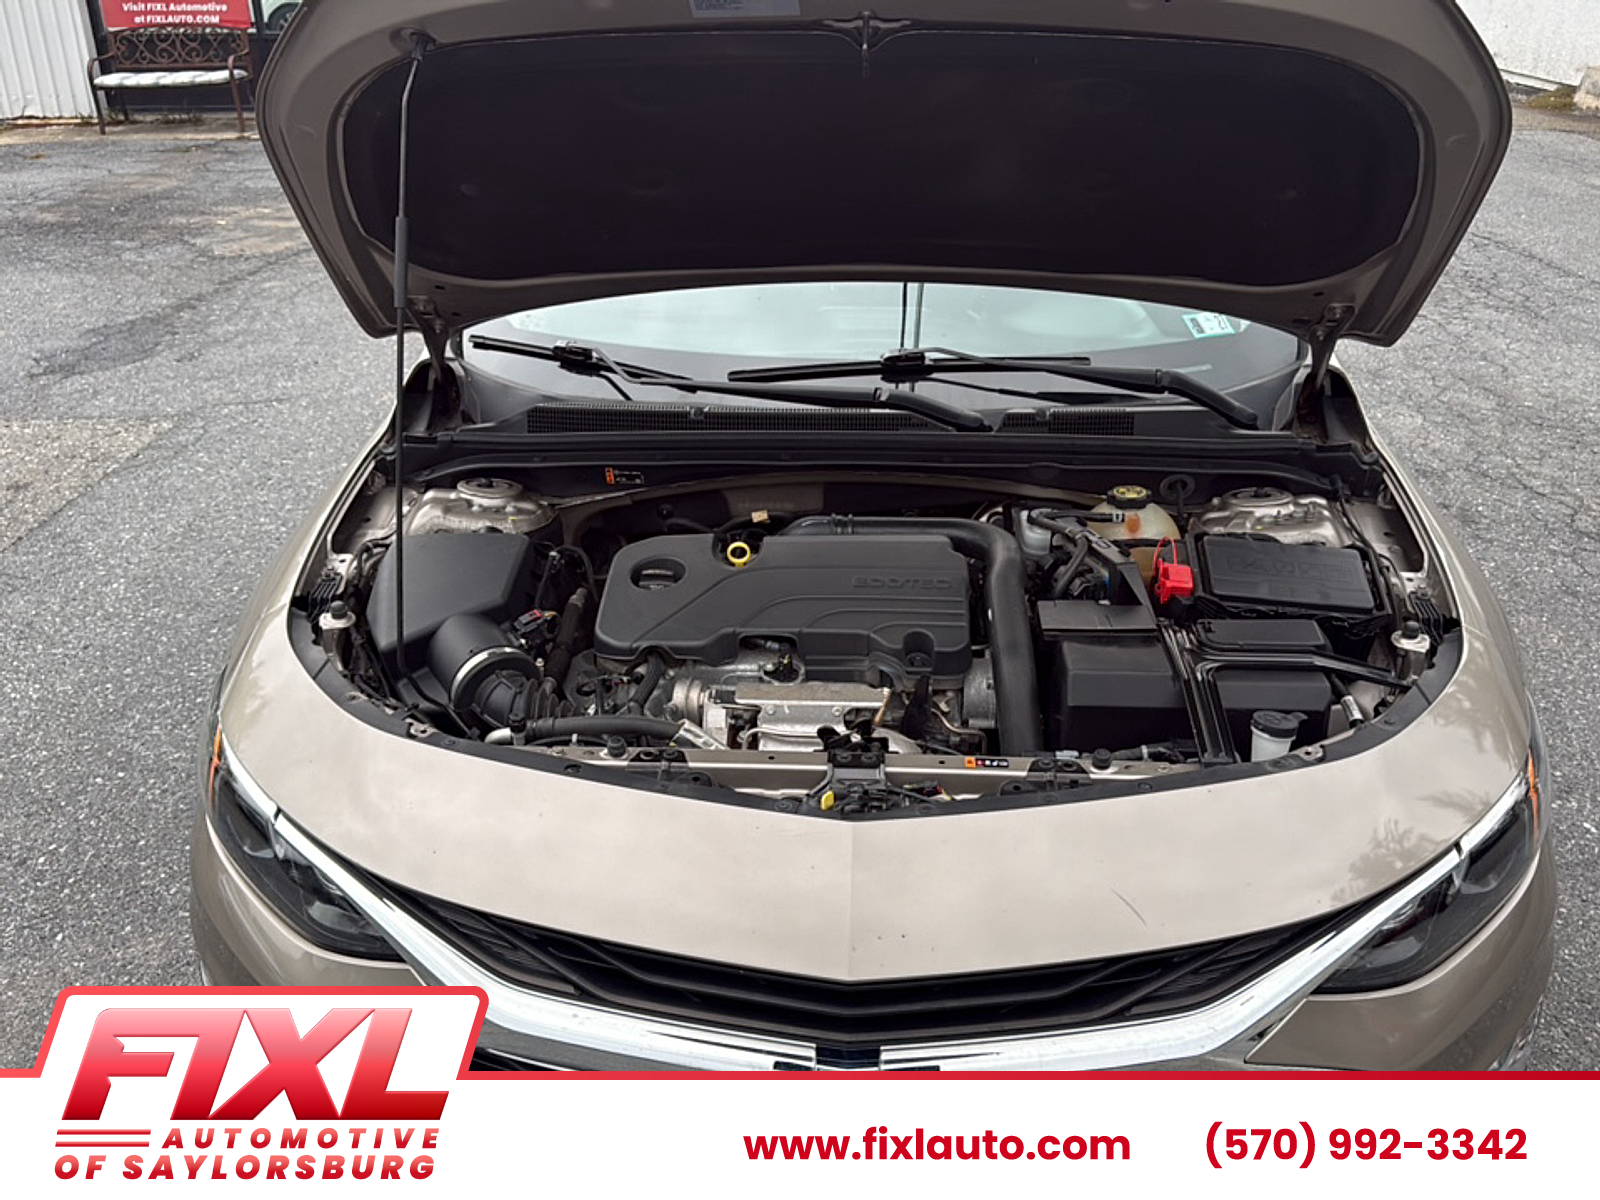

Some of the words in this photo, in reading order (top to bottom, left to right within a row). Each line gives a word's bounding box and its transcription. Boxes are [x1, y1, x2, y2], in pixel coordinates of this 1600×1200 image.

[122, 2, 144, 12] Visit
[147, 3, 167, 12] FIXL
[169, 2, 228, 12] Automotive
[134, 15, 145, 24] at
[147, 15, 220, 24] FIXLAUTO.COM
